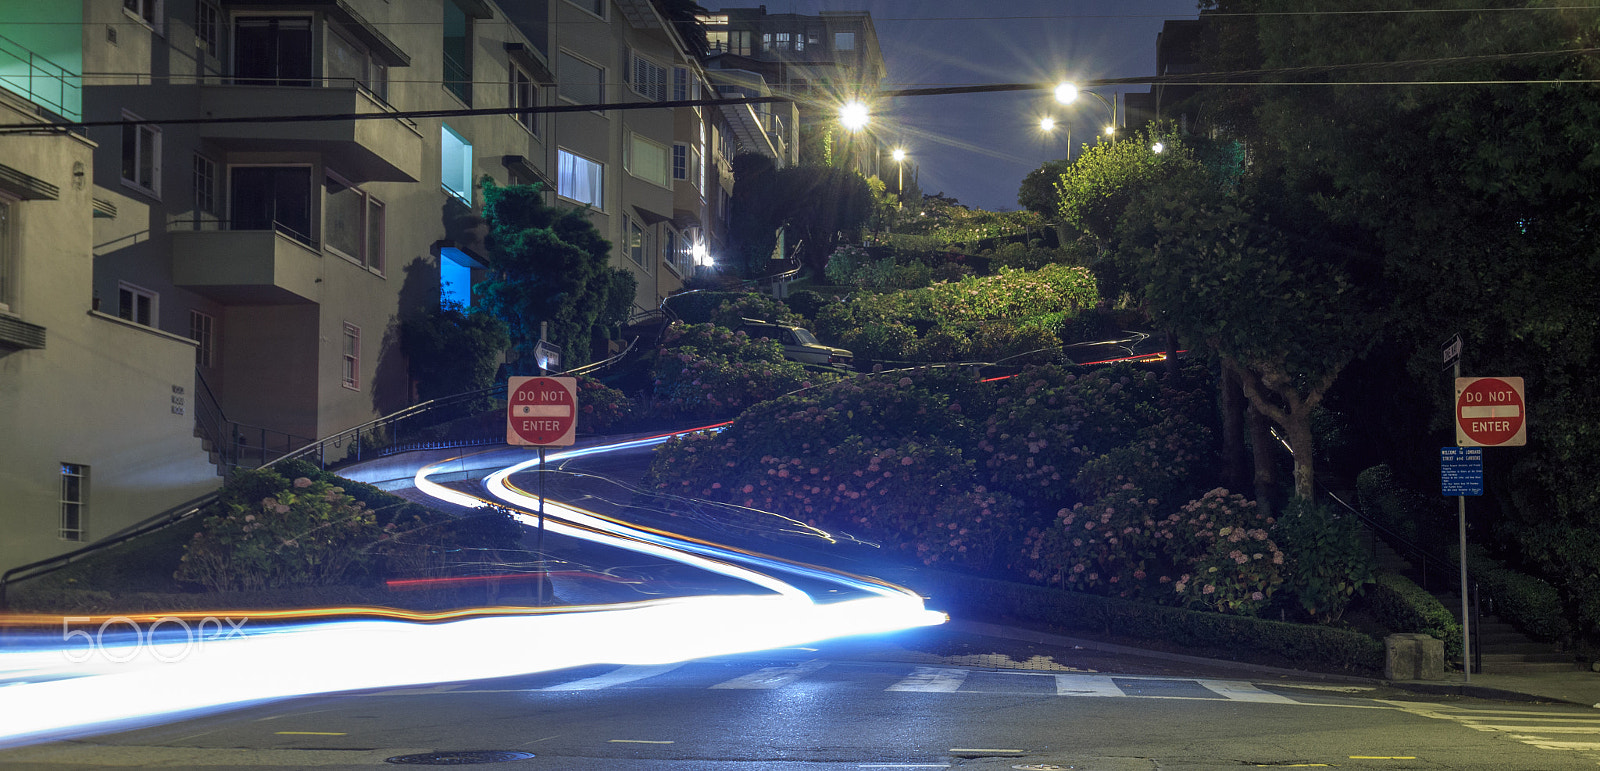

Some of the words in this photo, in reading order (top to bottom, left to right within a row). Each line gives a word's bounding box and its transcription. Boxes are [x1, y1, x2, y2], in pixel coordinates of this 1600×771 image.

[519, 391, 535, 401] DO
[541, 391, 565, 401] NOT
[1466, 392, 1482, 402] DO
[1489, 391, 1513, 402] NOT
[523, 421, 560, 431] ENTER
[1472, 421, 1510, 432] ENTER
